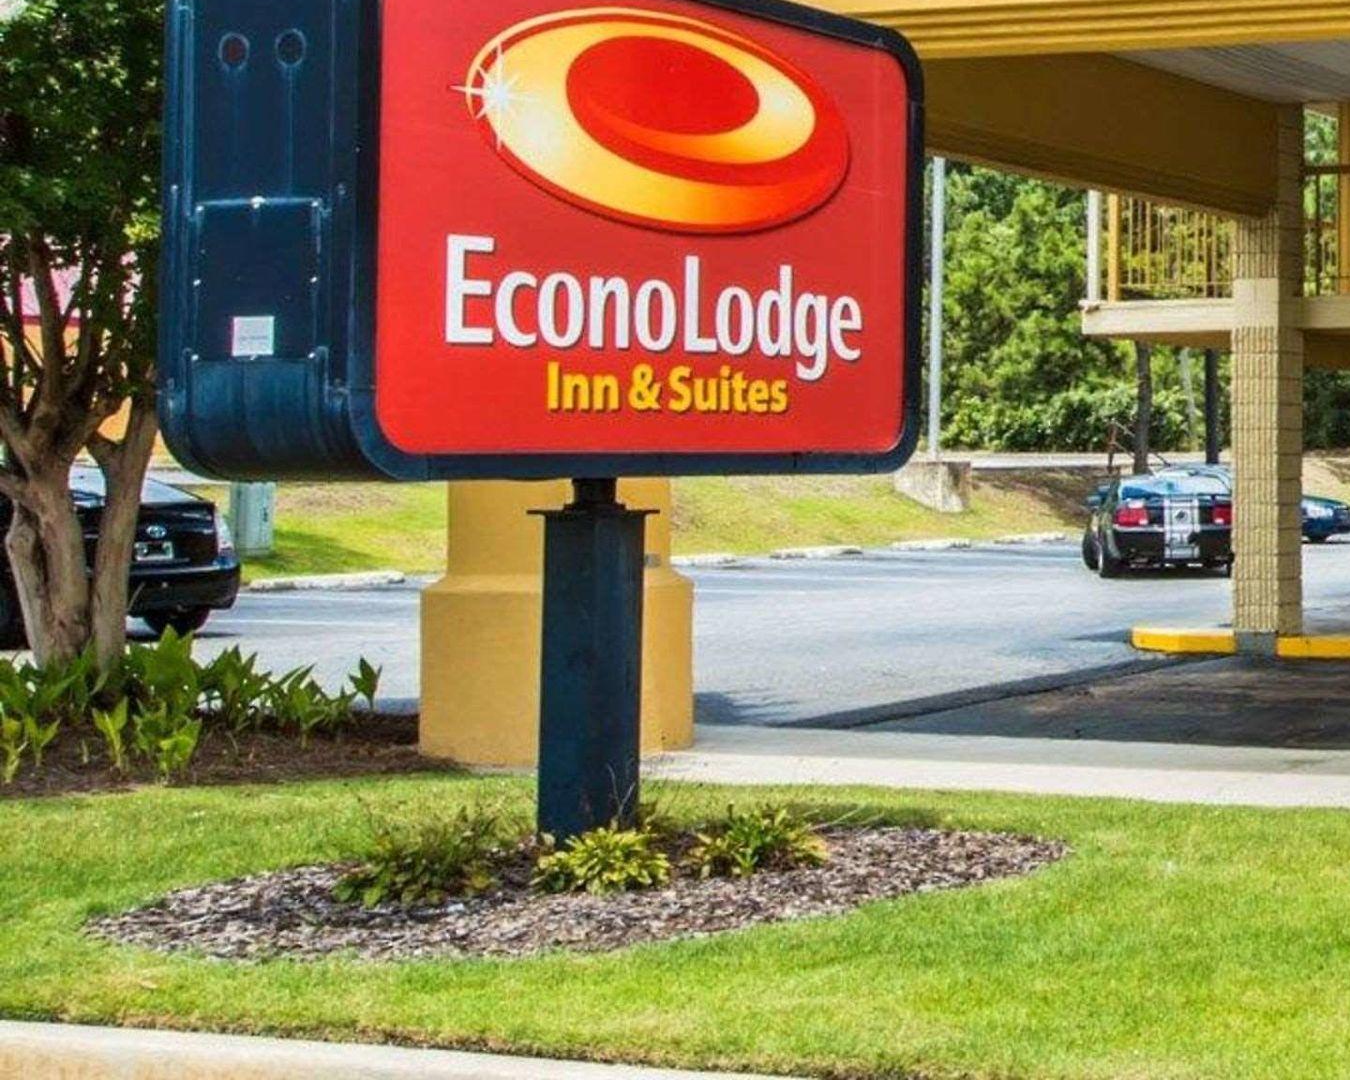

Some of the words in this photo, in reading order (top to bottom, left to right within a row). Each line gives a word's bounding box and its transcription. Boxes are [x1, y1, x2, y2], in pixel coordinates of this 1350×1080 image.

[445, 234, 863, 381] EconoLodge
[547, 361, 619, 411] Inn
[628, 363, 661, 411] &
[668, 366, 788, 413] Suites
